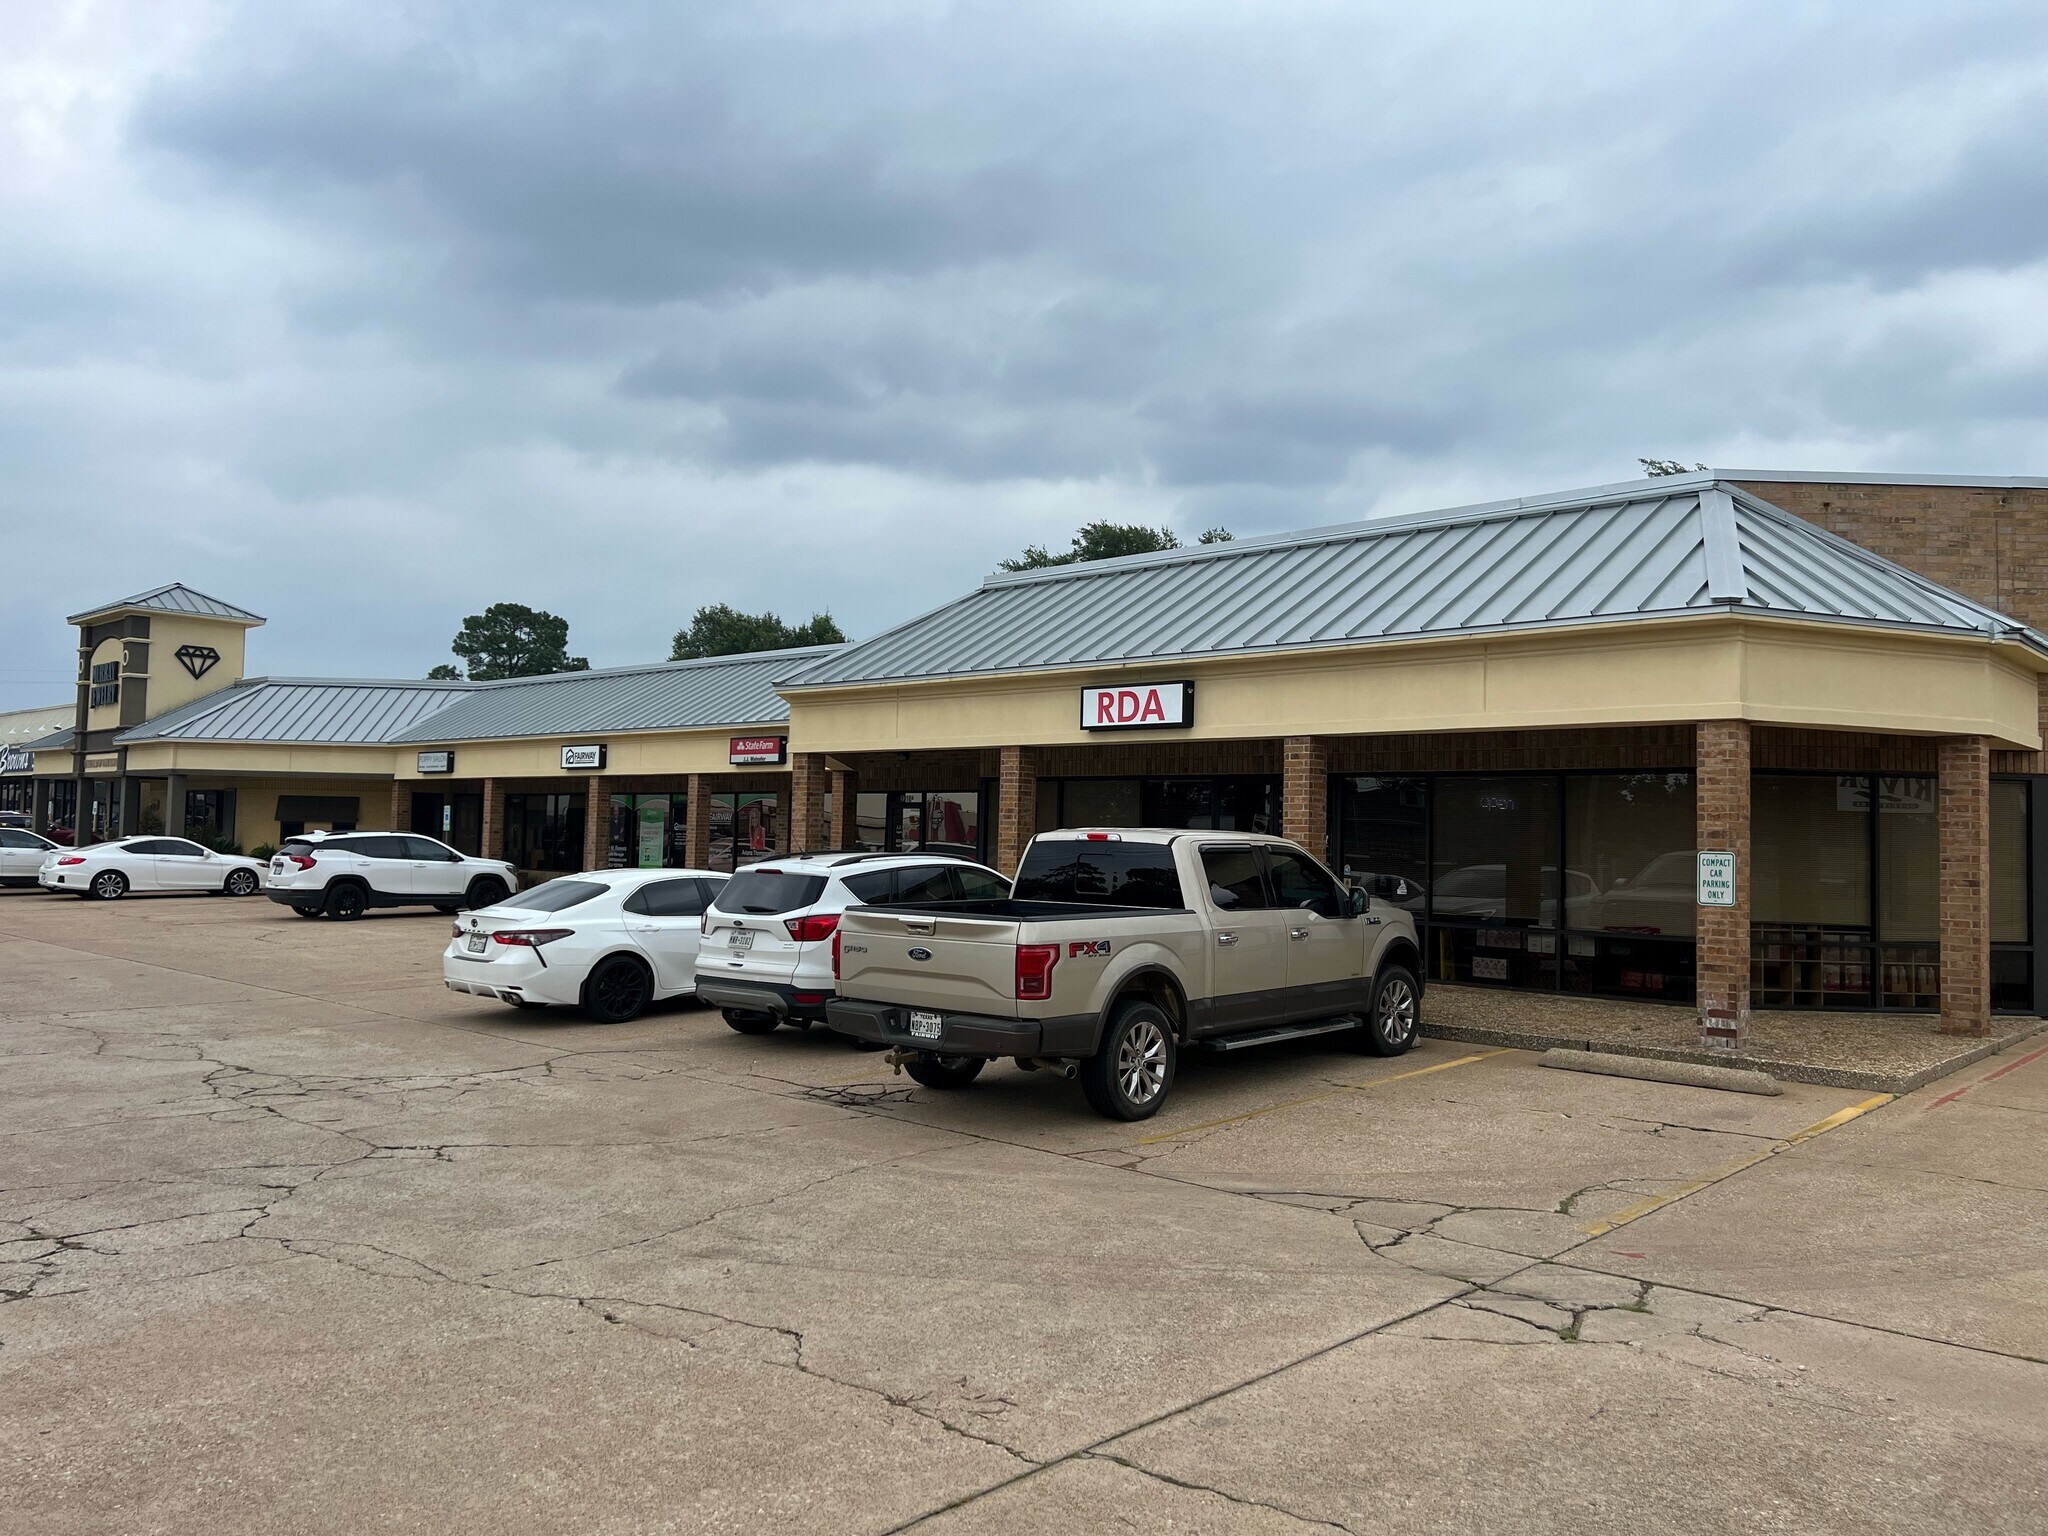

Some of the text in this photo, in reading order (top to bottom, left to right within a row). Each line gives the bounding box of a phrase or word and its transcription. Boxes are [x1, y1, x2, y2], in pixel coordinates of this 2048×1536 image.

[1098, 689, 1165, 723] RDA
[575, 752, 596, 760] FAIRWAY
[1702, 858, 1731, 867] COMPACT
[1710, 869, 1723, 878] CAR
[1702, 879, 1730, 889] PARKING
[1707, 890, 1725, 899] ONLY
[1069, 940, 1111, 958] FX4
[911, 1031, 939, 1040] FAIRWAY
